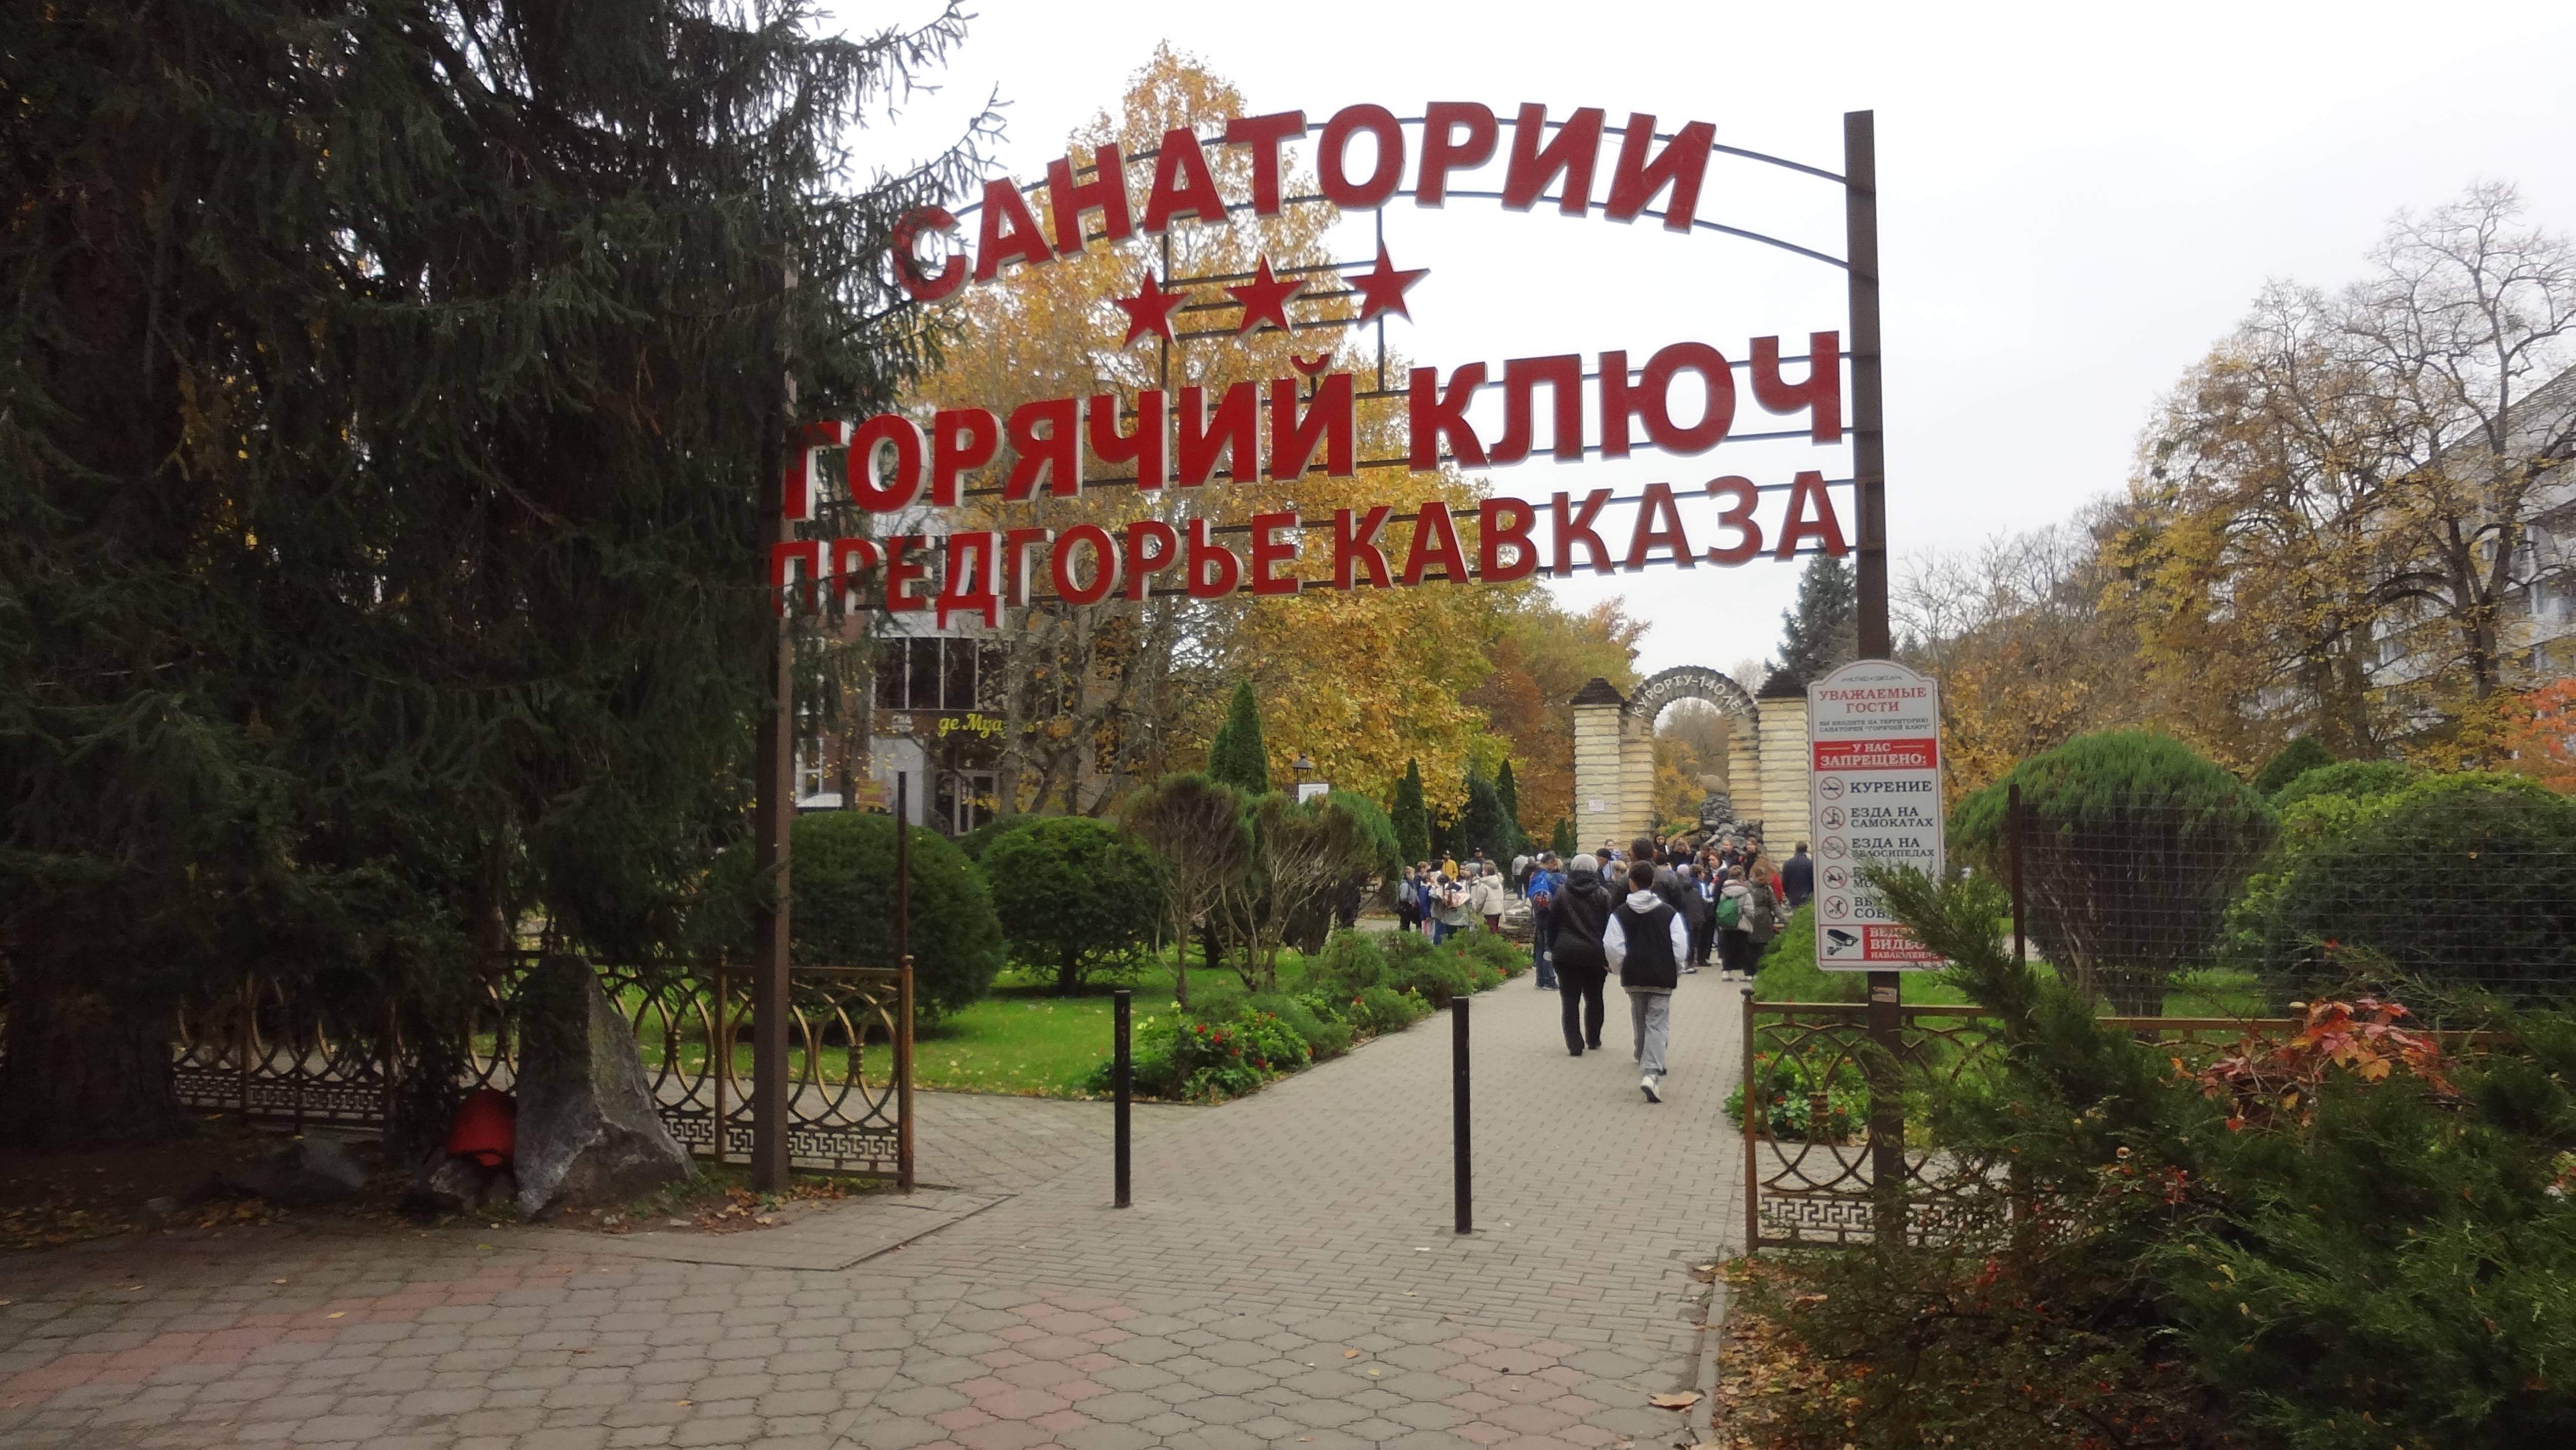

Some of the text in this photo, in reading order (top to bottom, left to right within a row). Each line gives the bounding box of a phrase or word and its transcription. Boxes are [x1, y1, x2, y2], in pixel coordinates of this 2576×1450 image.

[892, 101, 1716, 306] САНАТОРИИ
[784, 330, 1842, 522] ГОРЯЧИЙ КЛЮЧ
[771, 470, 1850, 629] ПРЕДГОРЬЕ КАВКАЗА
[1818, 687, 1927, 701] УВАЖАЕМЫЕ
[1846, 702, 1899, 713] ГОСТИ
[1852, 743, 1891, 752] У НАС
[1820, 753, 1926, 767] ЗАПРЕЩЕНО:
[1850, 781, 1933, 793] КУРЕНИЕ
[1850, 806, 1919, 818] ЕЗДА НА
[1851, 818, 1934, 828] САМОКАТАХ
[1851, 837, 1920, 849] ЕЗДА НА
